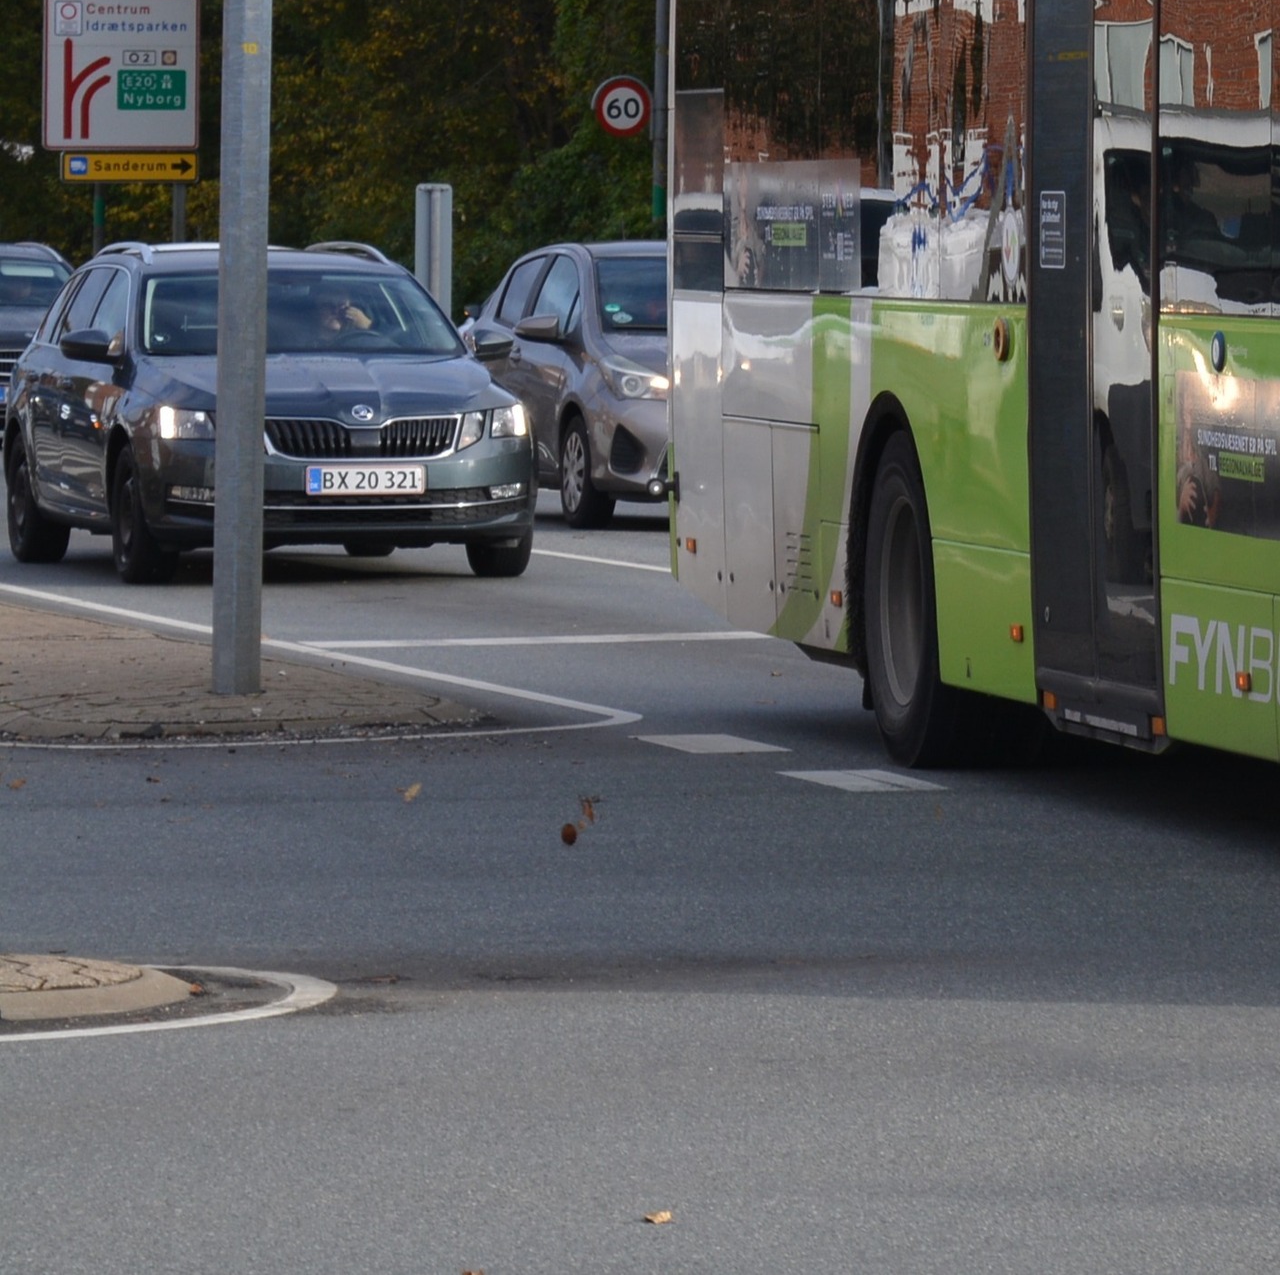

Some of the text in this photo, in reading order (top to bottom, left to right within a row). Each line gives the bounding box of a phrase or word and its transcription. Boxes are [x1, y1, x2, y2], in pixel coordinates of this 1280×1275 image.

[86, 3, 151, 15] Centrum
[86, 20, 188, 34] Idrætsparken
[126, 76, 151, 86] E20
[123, 93, 182, 106] Nyborg
[607, 98, 640, 119] 60
[93, 160, 167, 171] Sanderum
[323, 471, 349, 490] BX
[355, 471, 379, 490] 20
[384, 471, 418, 489] 321
